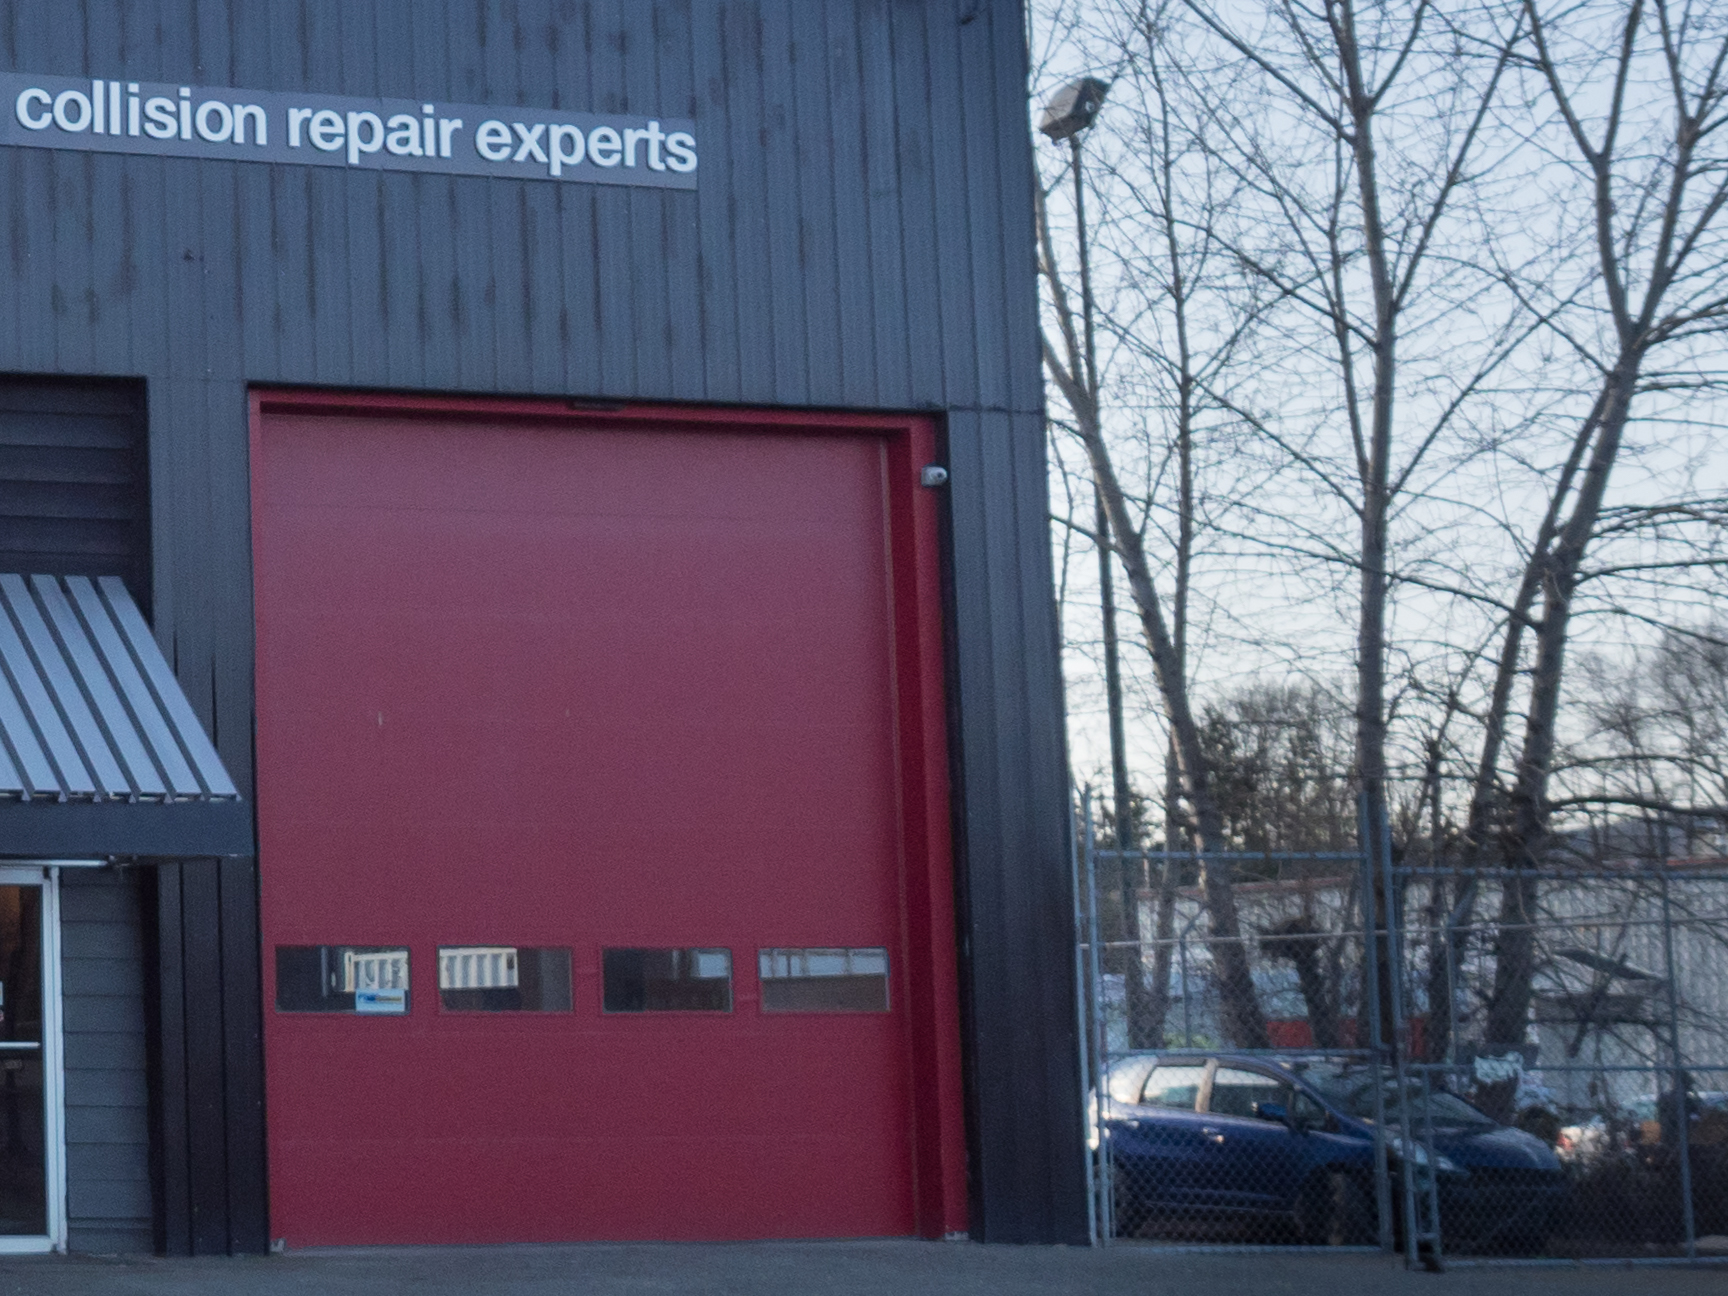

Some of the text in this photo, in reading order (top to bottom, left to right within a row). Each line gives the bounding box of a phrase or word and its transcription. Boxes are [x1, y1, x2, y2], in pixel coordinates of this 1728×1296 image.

[15, 79, 268, 146] collision
[286, 103, 463, 165] repair
[475, 119, 699, 177] experts
